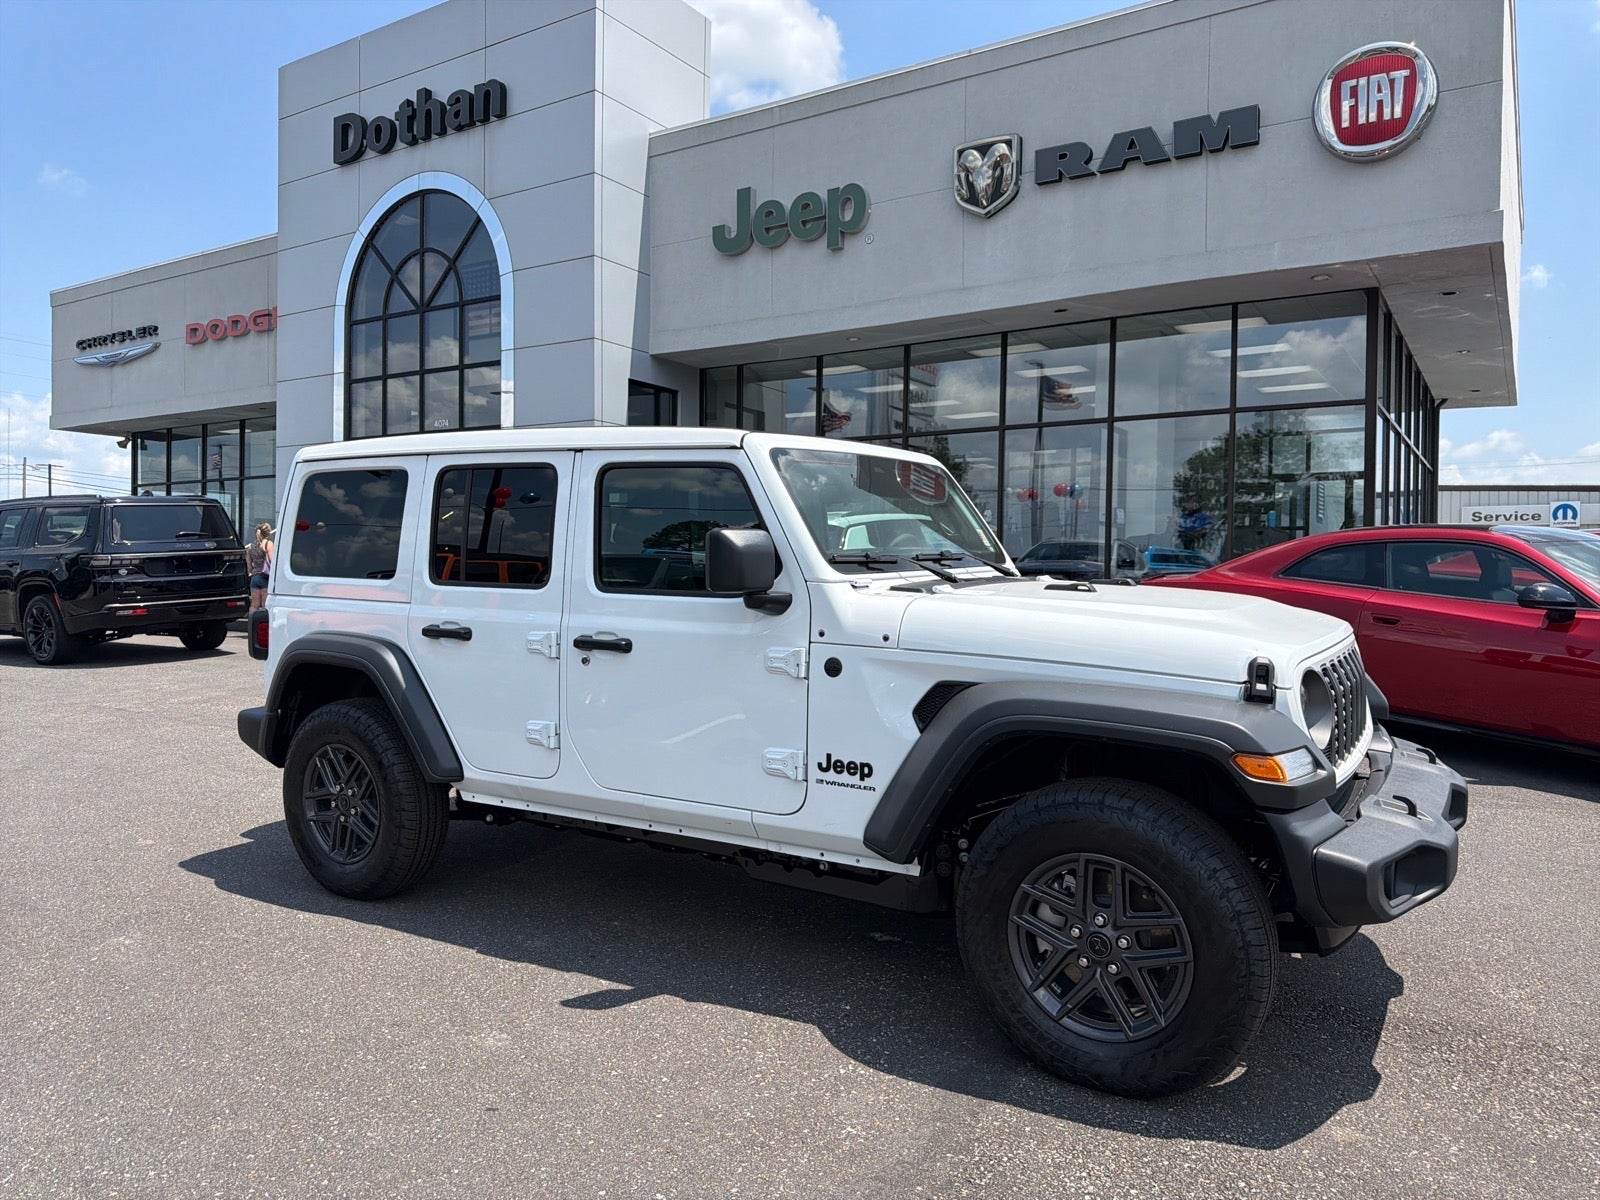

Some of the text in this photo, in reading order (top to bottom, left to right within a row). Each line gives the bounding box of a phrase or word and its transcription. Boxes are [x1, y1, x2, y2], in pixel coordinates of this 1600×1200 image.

[1341, 69, 1410, 129] FIAT
[333, 79, 507, 165] Dothan
[1034, 104, 1261, 186] RAM
[712, 183, 872, 256] Jeep
[75, 324, 159, 351] CHRYSLER
[434, 419, 449, 428] 4074
[1471, 511, 1542, 522] Service
[817, 753, 874, 781] Jeep
[825, 780, 876, 792] WRANGLER
